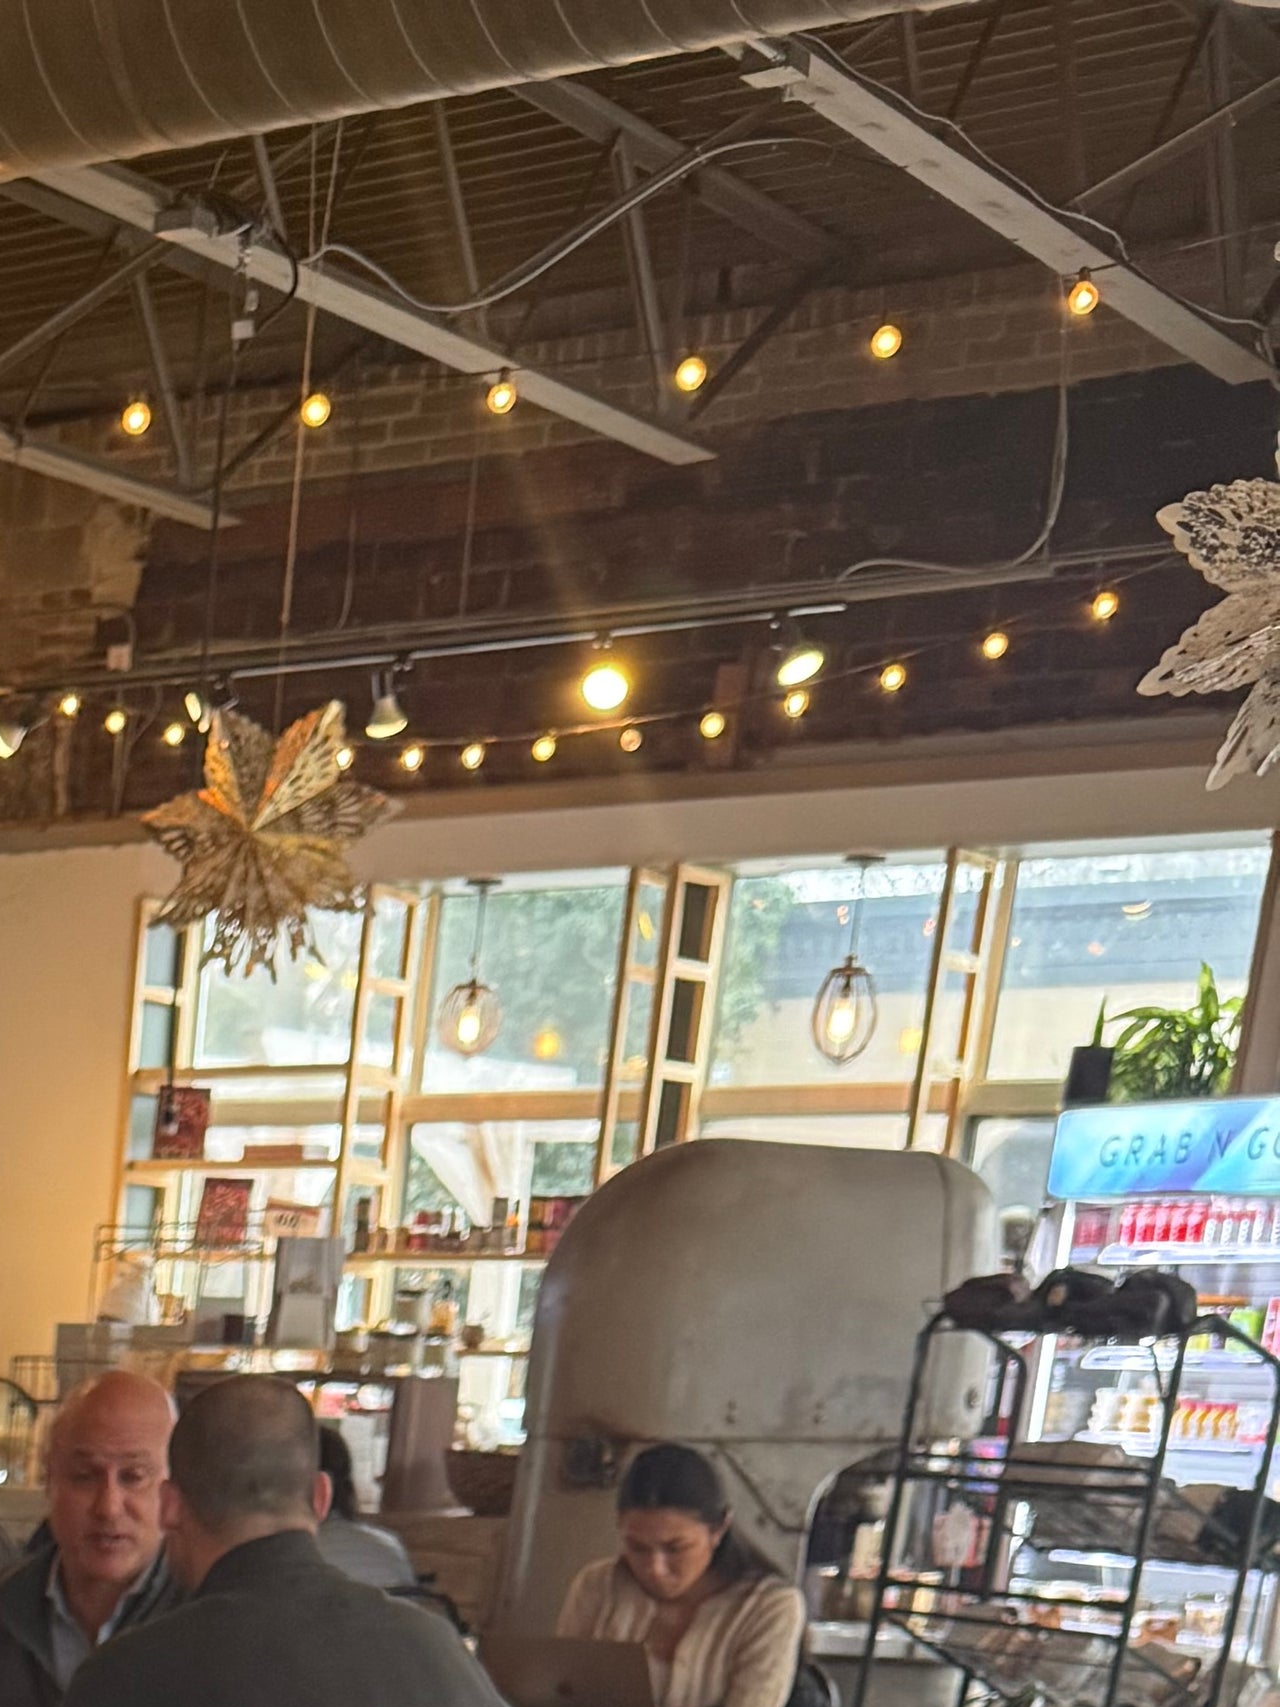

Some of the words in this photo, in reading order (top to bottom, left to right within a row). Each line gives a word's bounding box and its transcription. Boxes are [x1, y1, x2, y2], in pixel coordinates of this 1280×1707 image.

[1099, 1131, 1193, 1168] GRAB
[1207, 1128, 1233, 1164] N
[1246, 1125, 1280, 1161] G
